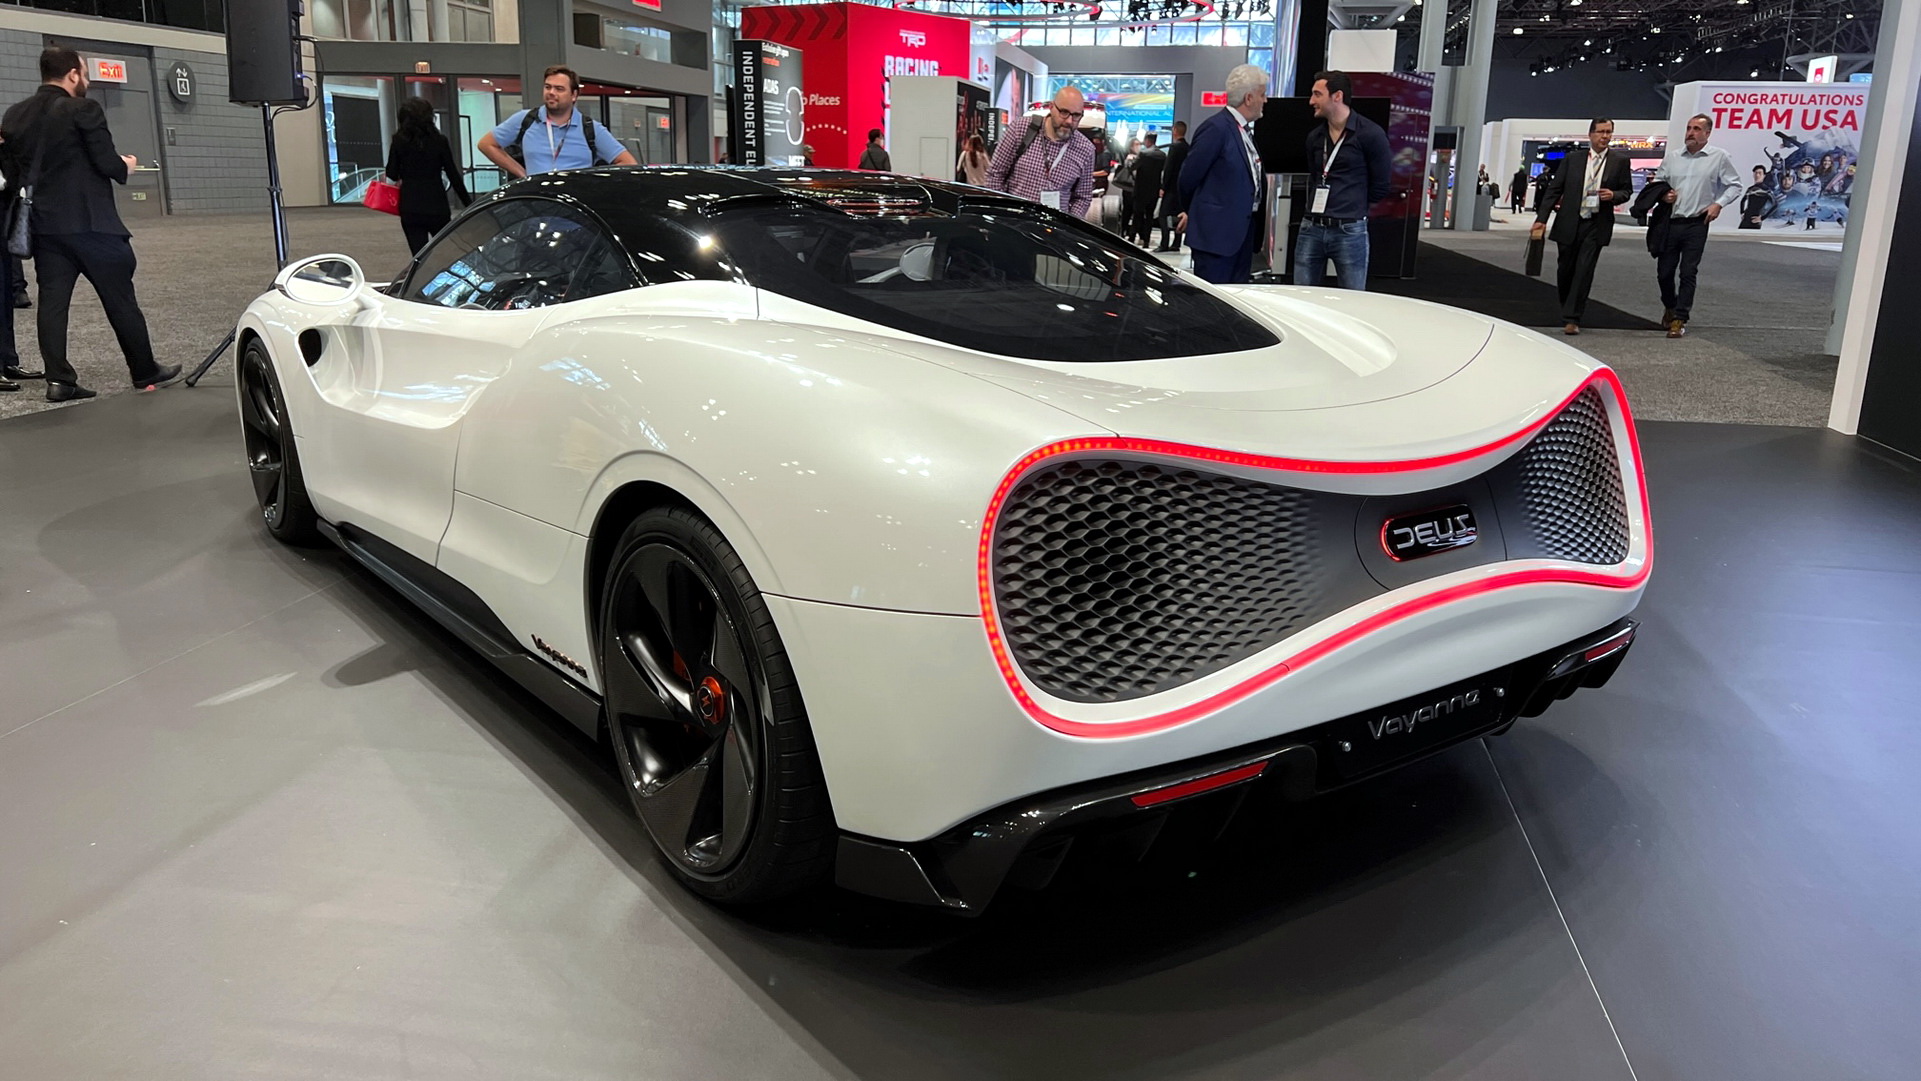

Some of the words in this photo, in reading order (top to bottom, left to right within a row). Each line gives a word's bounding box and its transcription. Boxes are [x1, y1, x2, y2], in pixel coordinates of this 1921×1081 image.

[899, 31, 926, 48] TRD
[98, 62, 124, 79] Exit
[884, 55, 939, 77] RACING
[742, 51, 756, 147] INDEPENDENT
[808, 93, 841, 106] Places
[1713, 92, 1864, 106] CONGRATULATIONS
[1712, 107, 1793, 130] TEAM
[1800, 109, 1859, 131] USA
[1393, 513, 1469, 550] DEUS
